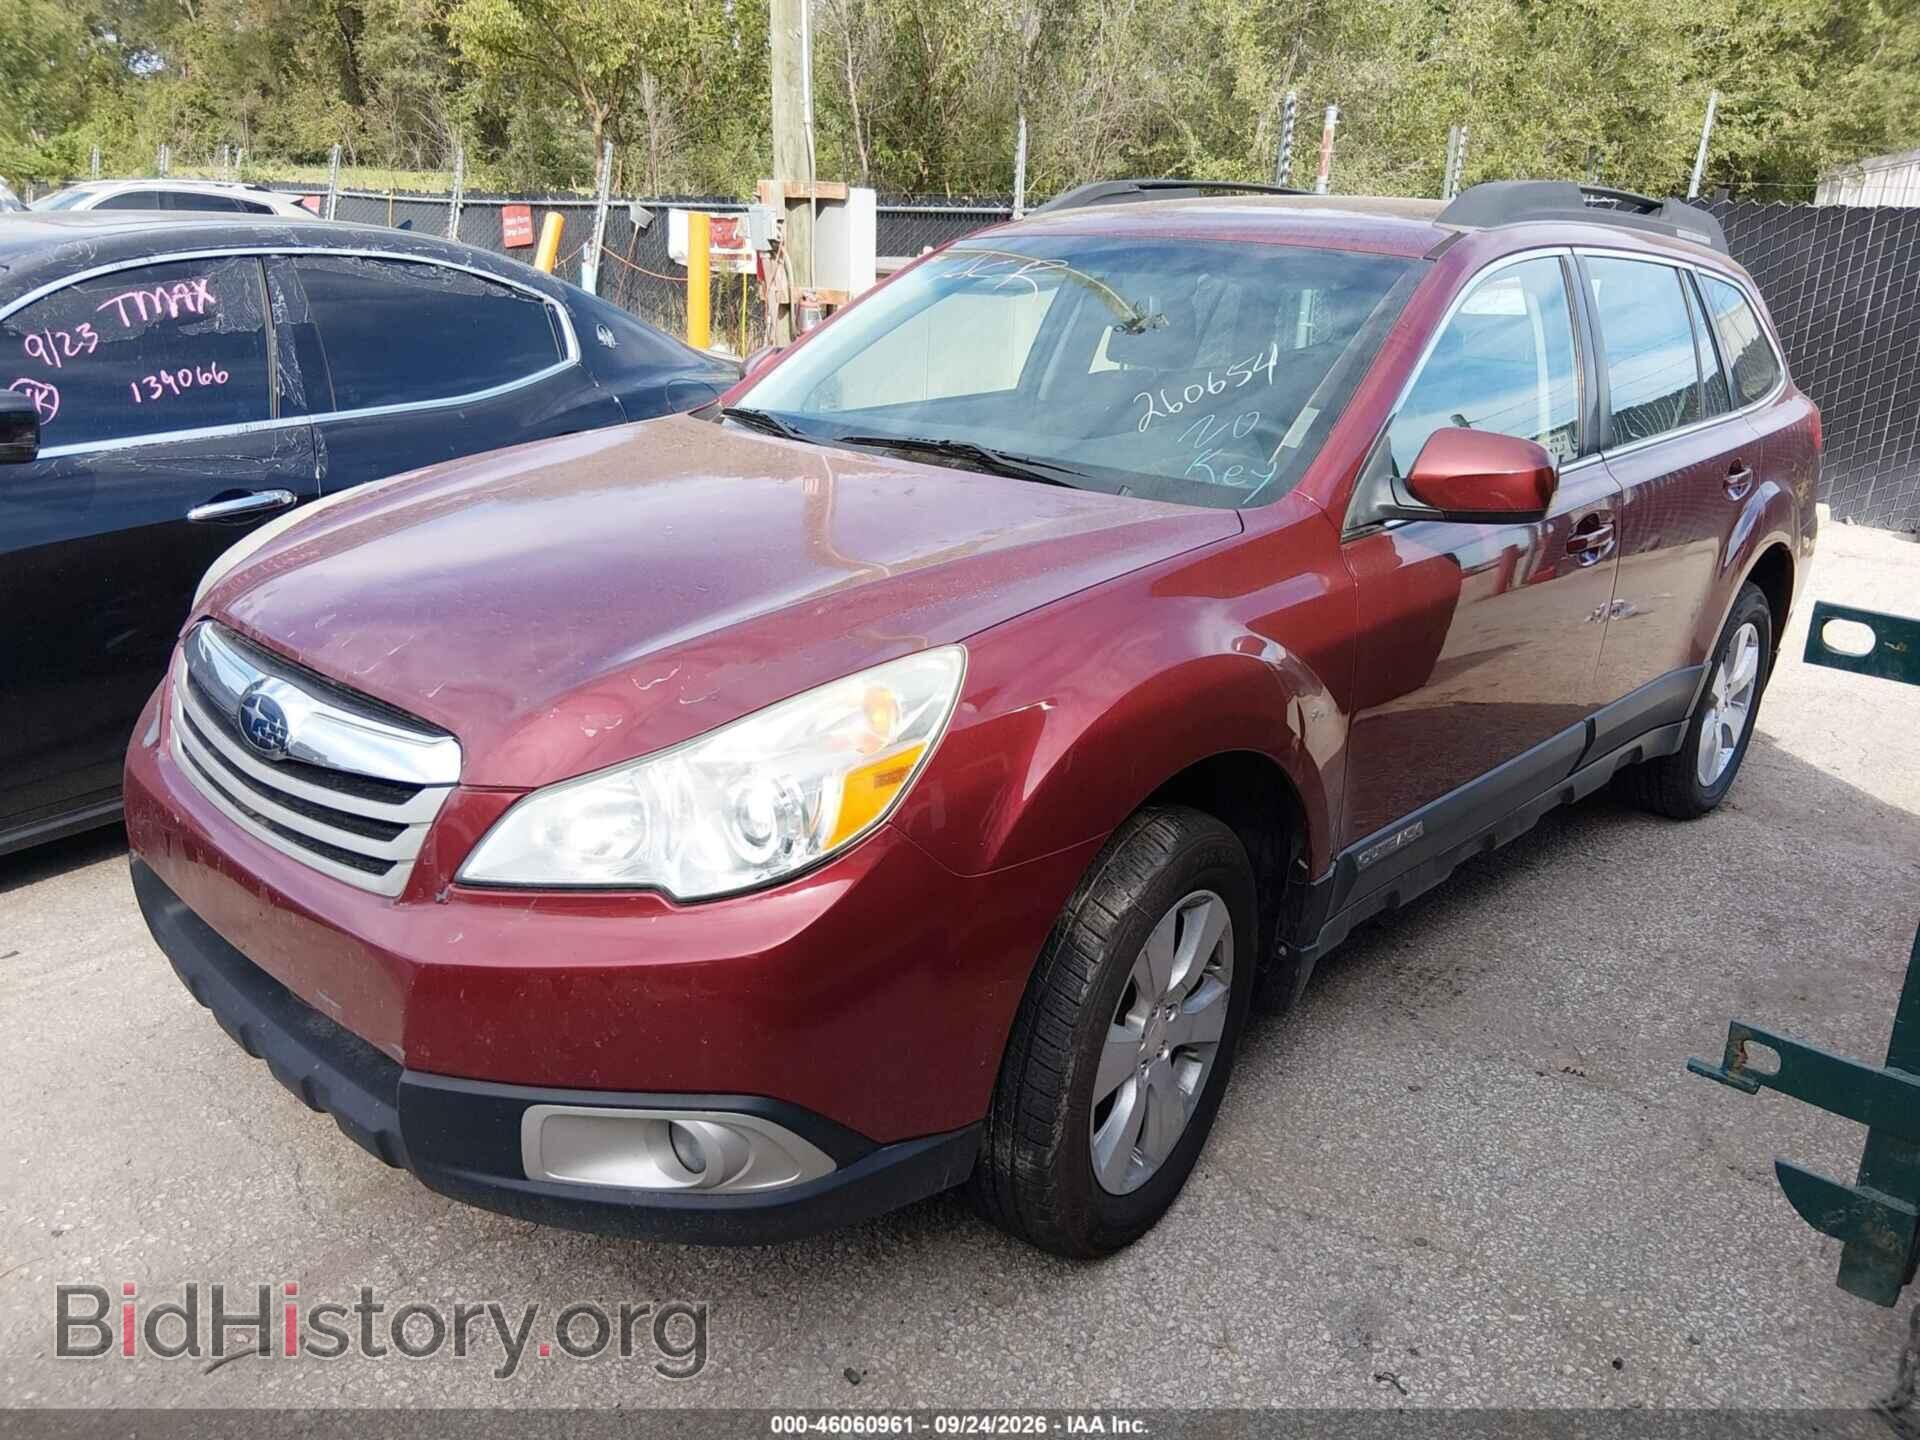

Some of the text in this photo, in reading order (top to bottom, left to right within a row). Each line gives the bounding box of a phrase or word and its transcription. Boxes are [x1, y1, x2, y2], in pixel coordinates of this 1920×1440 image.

[96, 278, 217, 327] TMAX
[24, 321, 99, 368] 9/23
[130, 360, 230, 404] 139066
[1132, 343, 1279, 433] 260654
[1184, 447, 1279, 505] Key
